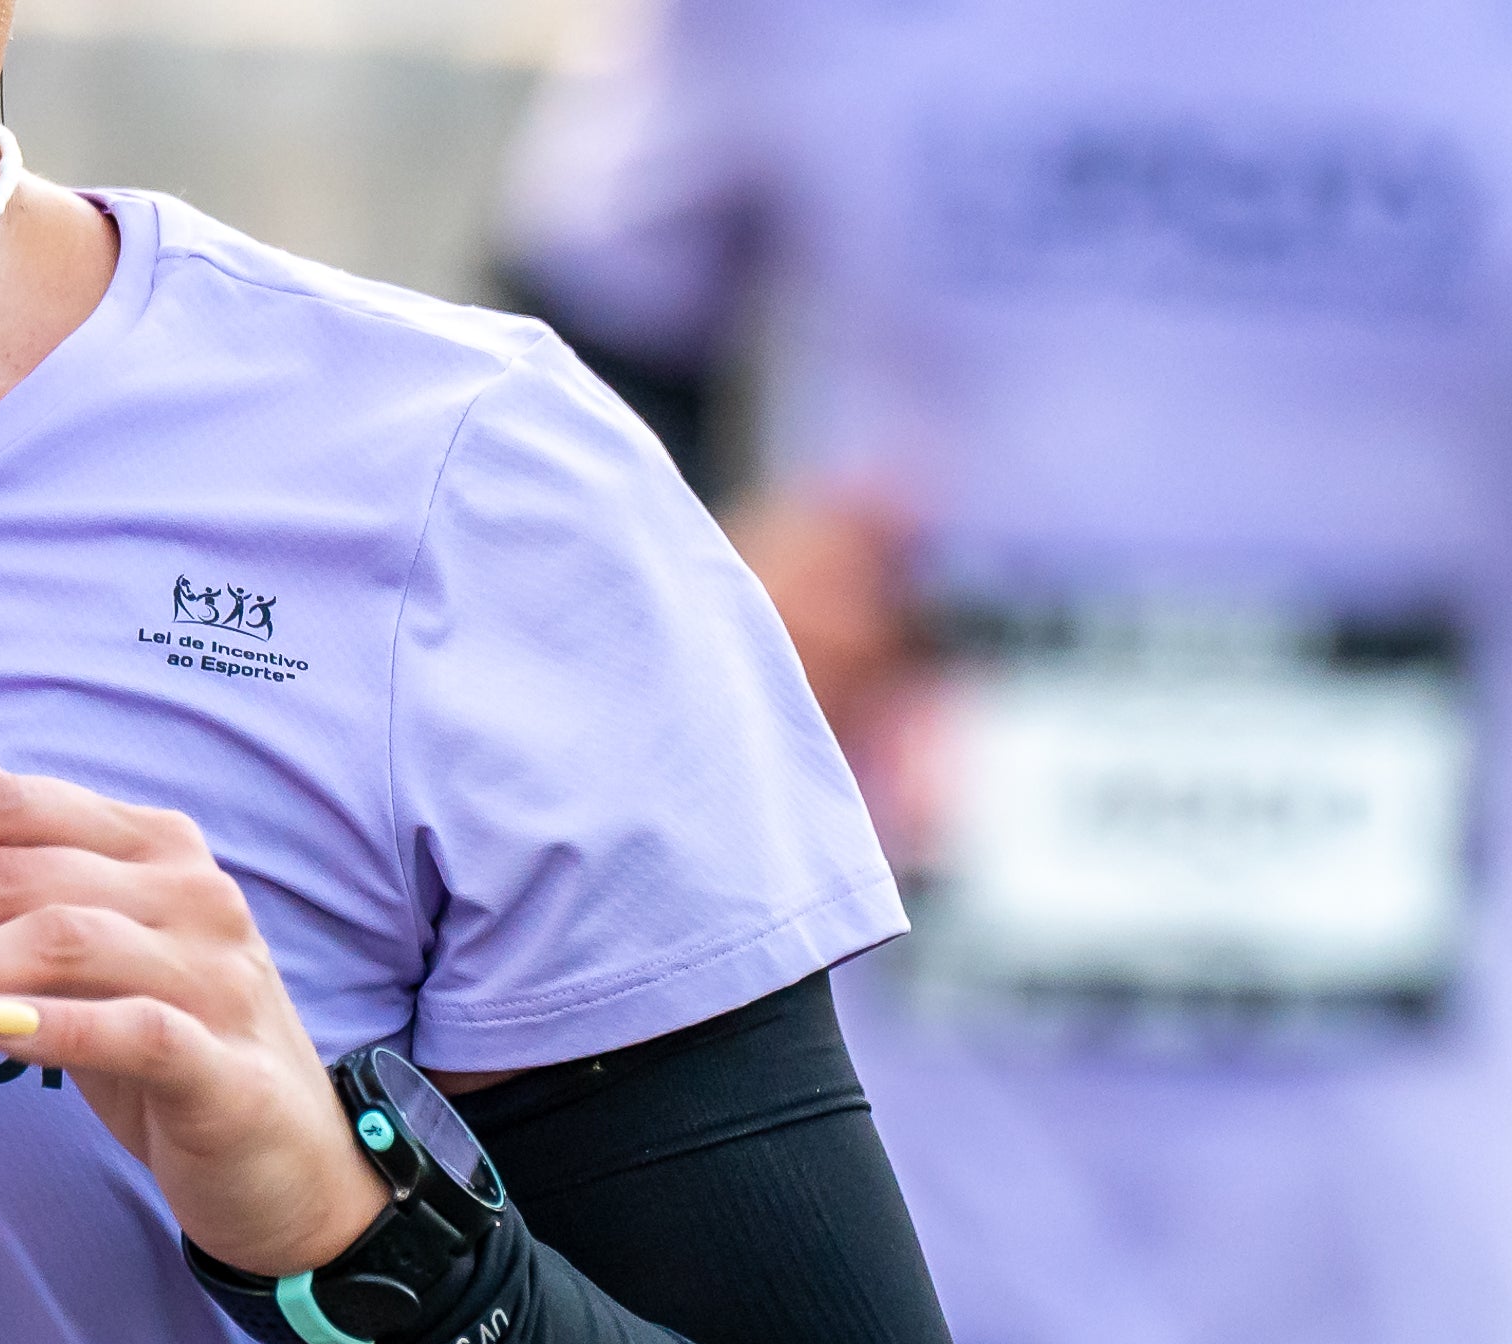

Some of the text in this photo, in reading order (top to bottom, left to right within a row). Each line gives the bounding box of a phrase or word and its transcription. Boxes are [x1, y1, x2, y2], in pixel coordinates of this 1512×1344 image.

[138, 628, 308, 671] Lei de Incentivo
[167, 653, 193, 667] ao
